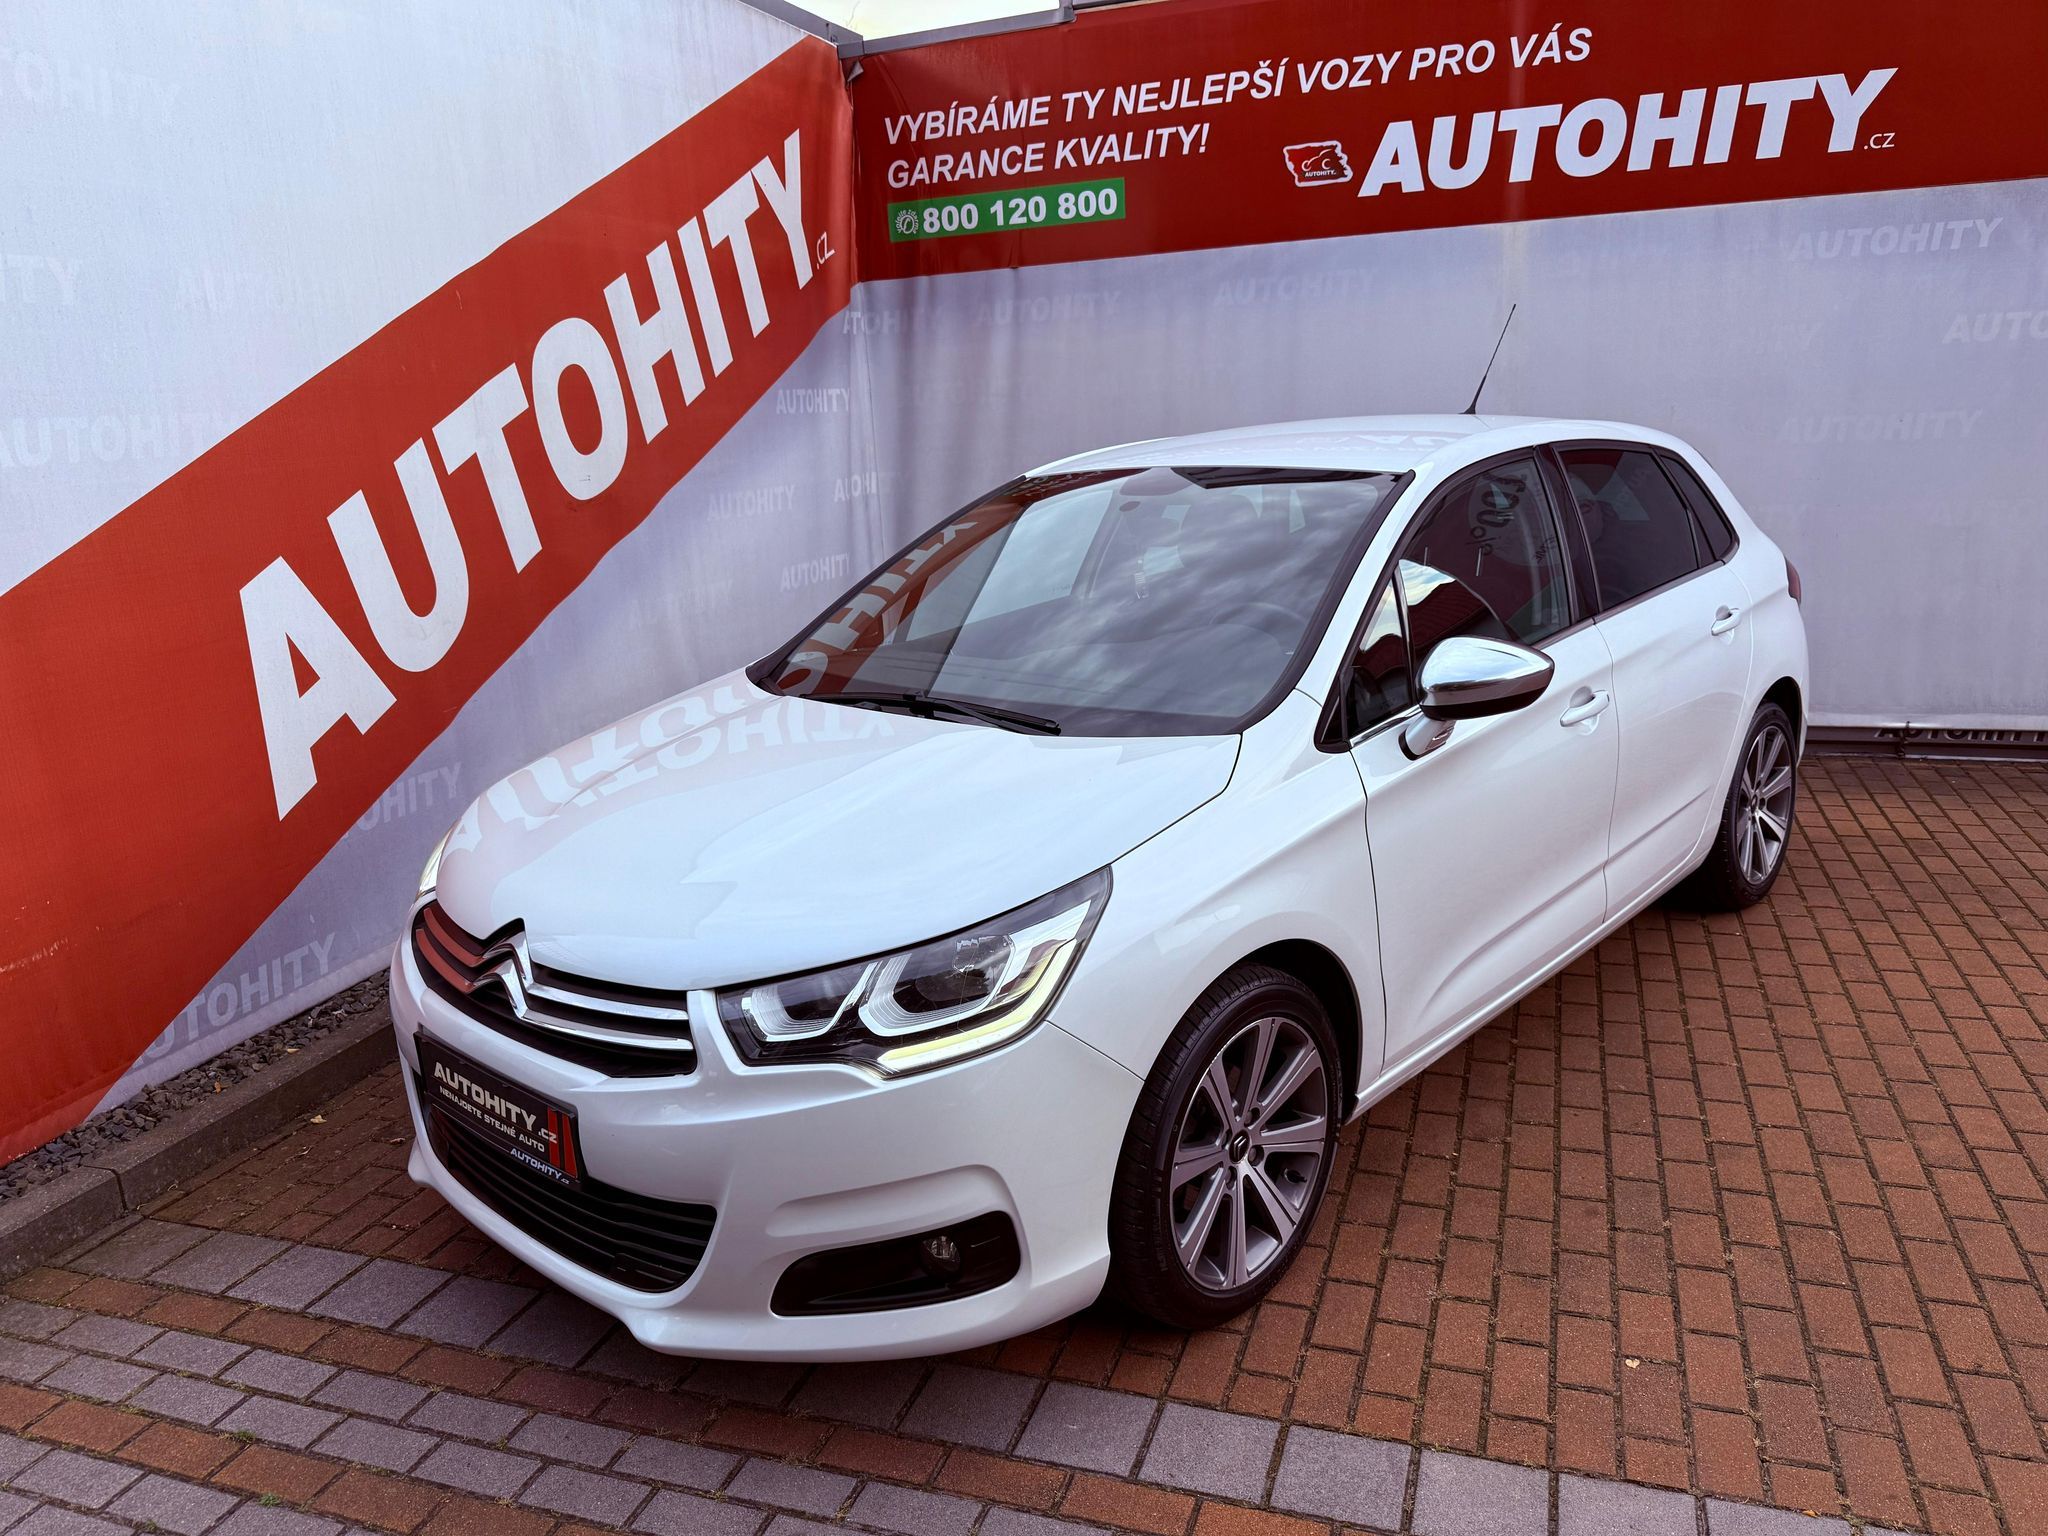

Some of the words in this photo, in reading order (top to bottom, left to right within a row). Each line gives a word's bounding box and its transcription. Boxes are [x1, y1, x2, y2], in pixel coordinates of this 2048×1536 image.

[884, 95, 1051, 145] VYBÍRÁME
[1061, 89, 1099, 123] TY
[1112, 57, 1290, 117] NEJLEPŠÍ
[1297, 50, 1402, 94] VOZY
[1409, 39, 1495, 81] PRO
[1510, 22, 1593, 69] VÁS
[888, 143, 1046, 189] GARANCE
[1054, 123, 1210, 170] KVALITY!
[923, 203, 979, 234] 800
[990, 197, 1046, 227] 120
[1058, 188, 1118, 219] 800
[1788, 217, 2003, 261] AUTOHITY
[439, 1085, 482, 1120] NENAJDETE
[484, 1113, 516, 1138] STEJNÉ
[518, 1133, 545, 1153] AUTO
